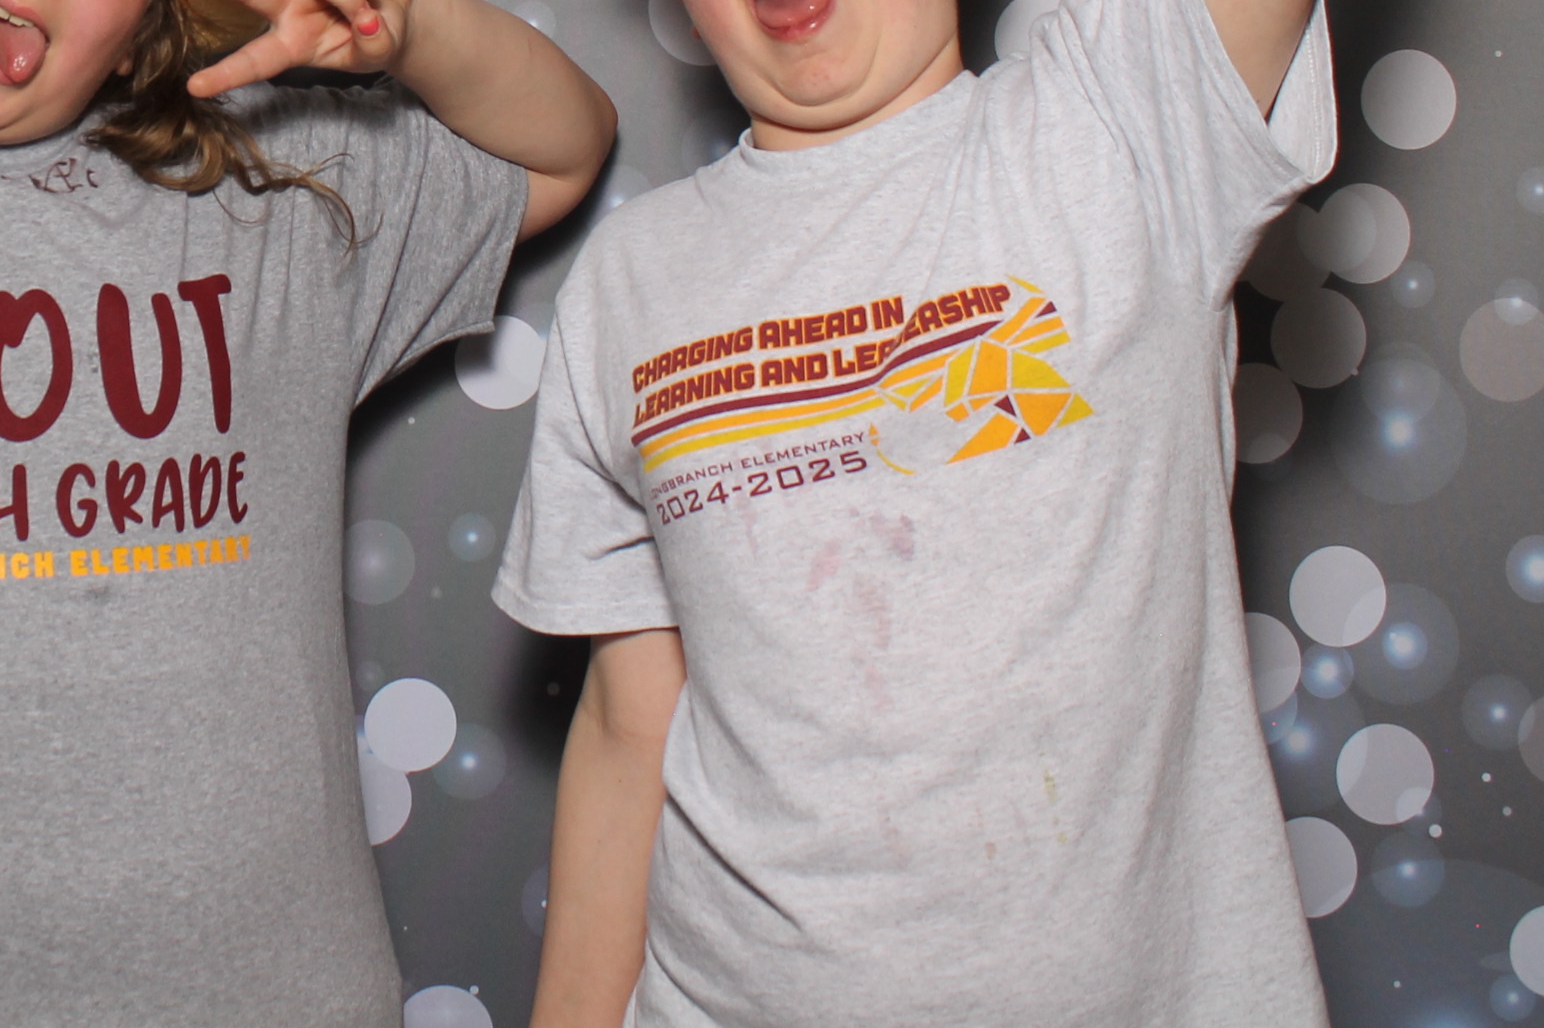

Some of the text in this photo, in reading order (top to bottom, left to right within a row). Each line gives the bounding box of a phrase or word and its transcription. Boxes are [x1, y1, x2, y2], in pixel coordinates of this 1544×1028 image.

[631, 295, 905, 394] CHARGING AHEAD IN
[631, 361, 755, 429] LEARNING
[760, 352, 829, 388] AND
[656, 450, 868, 525] 2024-2025
[741, 431, 865, 470] ELEMENTARY
[56, 451, 248, 538] GRADE
[69, 535, 252, 577] ELEMENTARY
